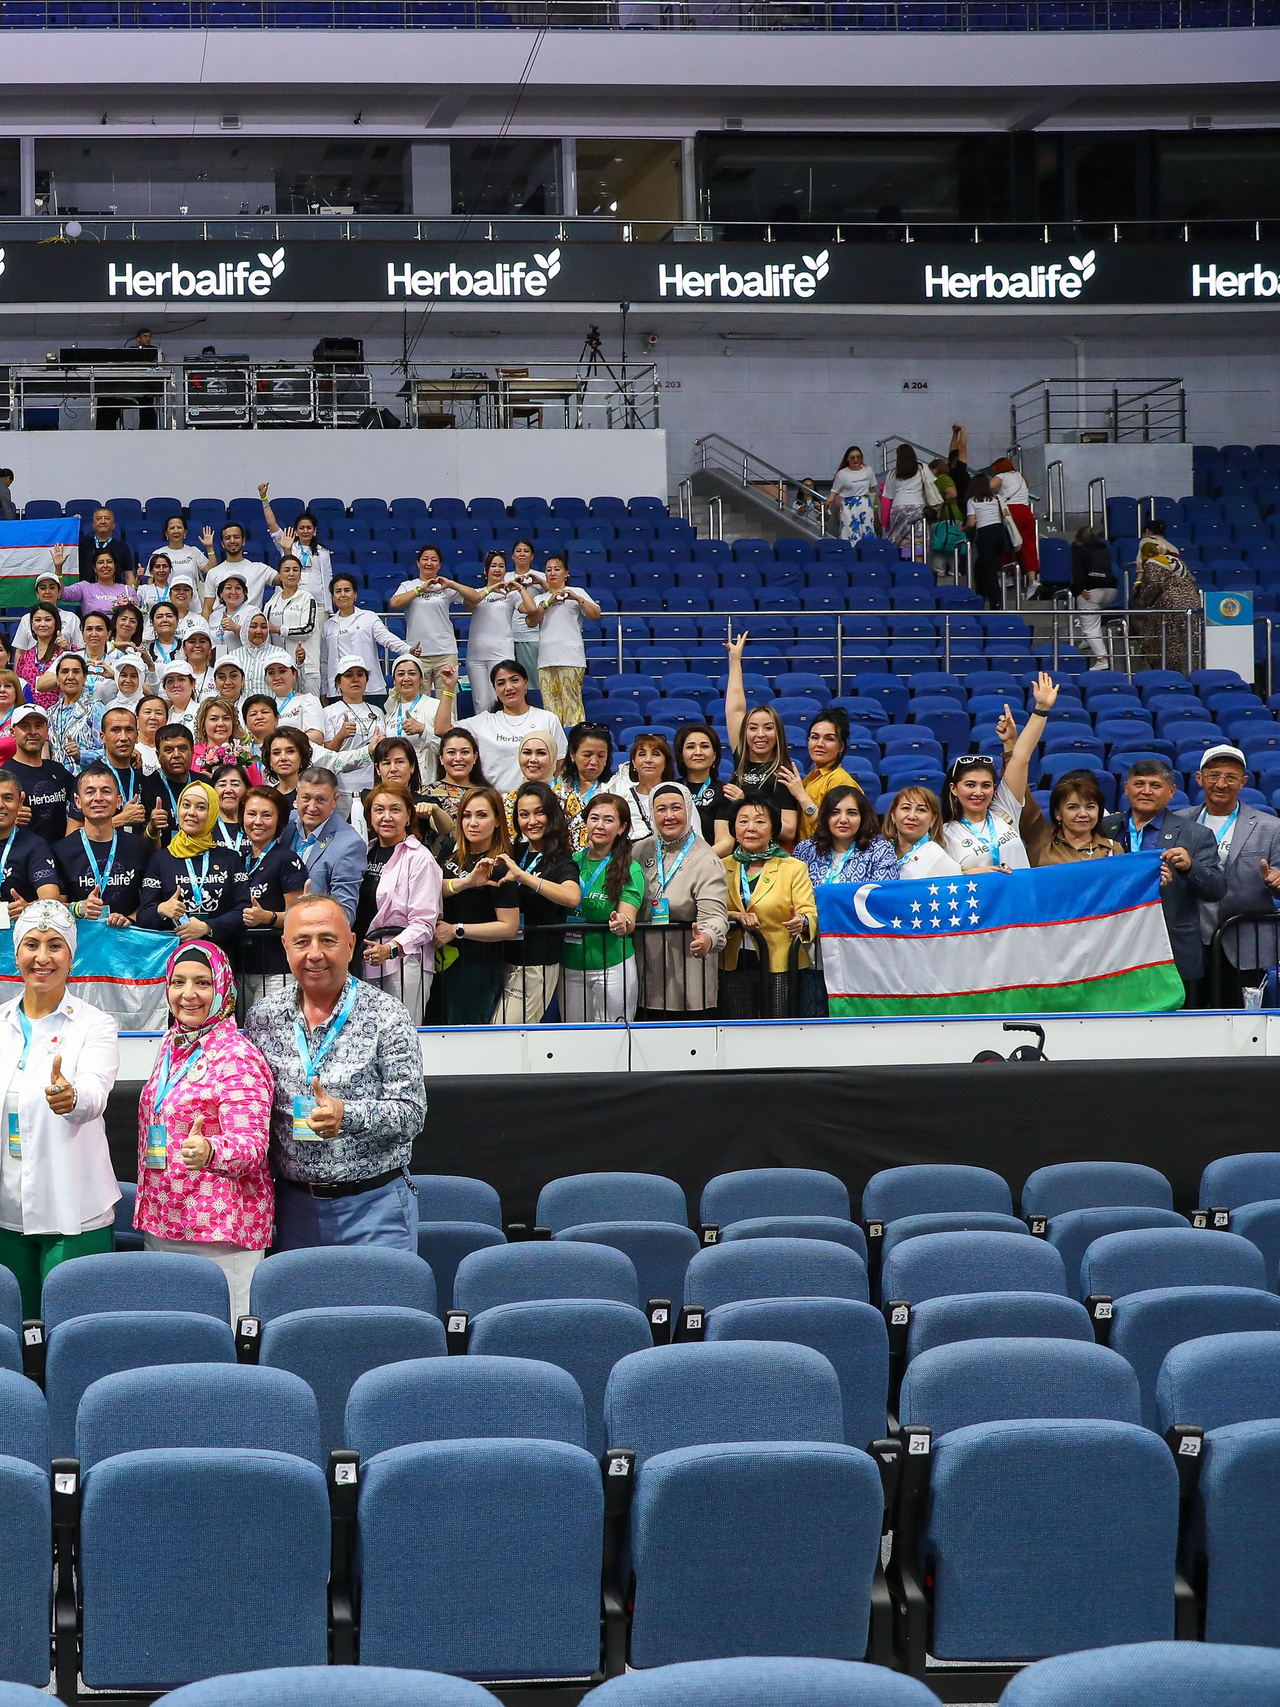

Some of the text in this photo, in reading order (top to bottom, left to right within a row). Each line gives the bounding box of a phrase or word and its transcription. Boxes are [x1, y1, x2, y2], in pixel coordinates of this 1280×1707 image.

[109, 262, 272, 297] Herbalife
[388, 261, 548, 296] Herbalife
[659, 262, 817, 298] Herbalife
[925, 264, 1083, 299] Herbalife
[1192, 263, 1280, 298] Herb
[665, 381, 682, 389] 203
[28, 790, 66, 806] Herbalife
[973, 831, 1018, 857] Healife
[79, 874, 131, 889] Healife
[1099, 1307, 1110, 1316] 23
[655, 1314, 663, 1322] 4
[894, 1313, 905, 1322] 22
[453, 1322, 460, 1331] 3
[690, 1319, 700, 1327] 21
[245, 1326, 252, 1335] 2
[31, 1334, 36, 1342] 1
[912, 1441, 925, 1451] 21
[1181, 1442, 1197, 1454] 22
[614, 1463, 622, 1473] 3
[340, 1470, 349, 1480] 2
[62, 1480, 68, 1490] 1
